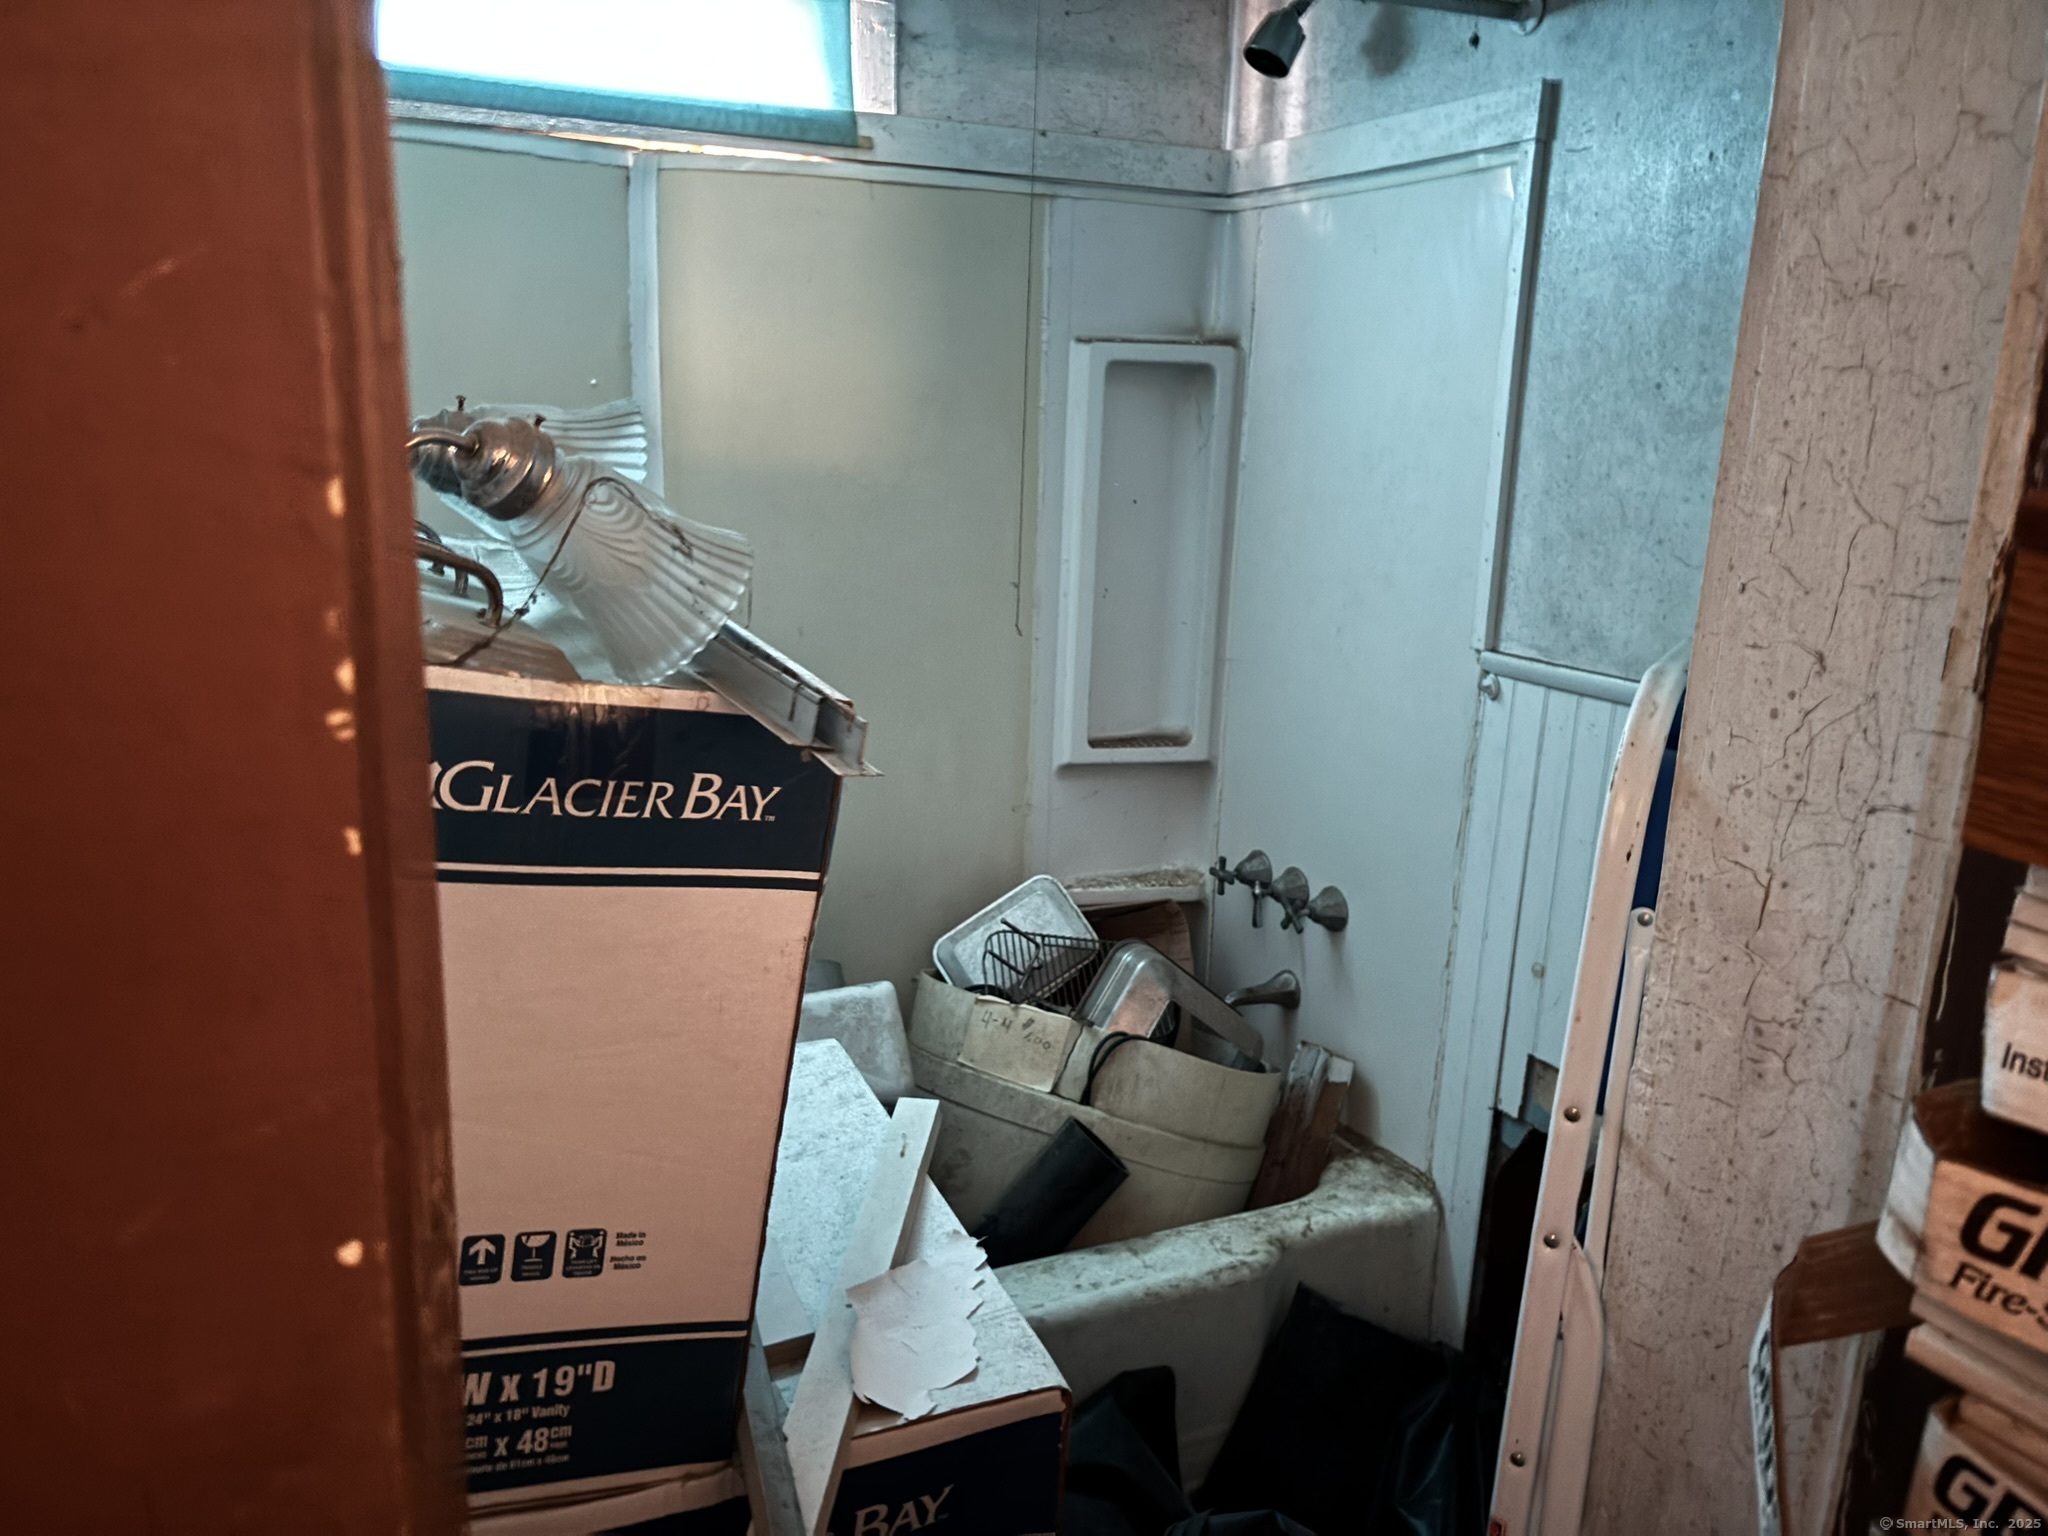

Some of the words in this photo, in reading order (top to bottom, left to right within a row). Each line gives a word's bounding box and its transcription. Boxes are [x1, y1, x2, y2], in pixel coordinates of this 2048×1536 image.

[439, 760, 673, 819] GLACIER
[1948, 1261, 2048, 1332] Fire-
[533, 1361, 615, 1398] 19"D
[506, 1407, 529, 1422] 18"
[532, 1404, 571, 1418] Vanity
